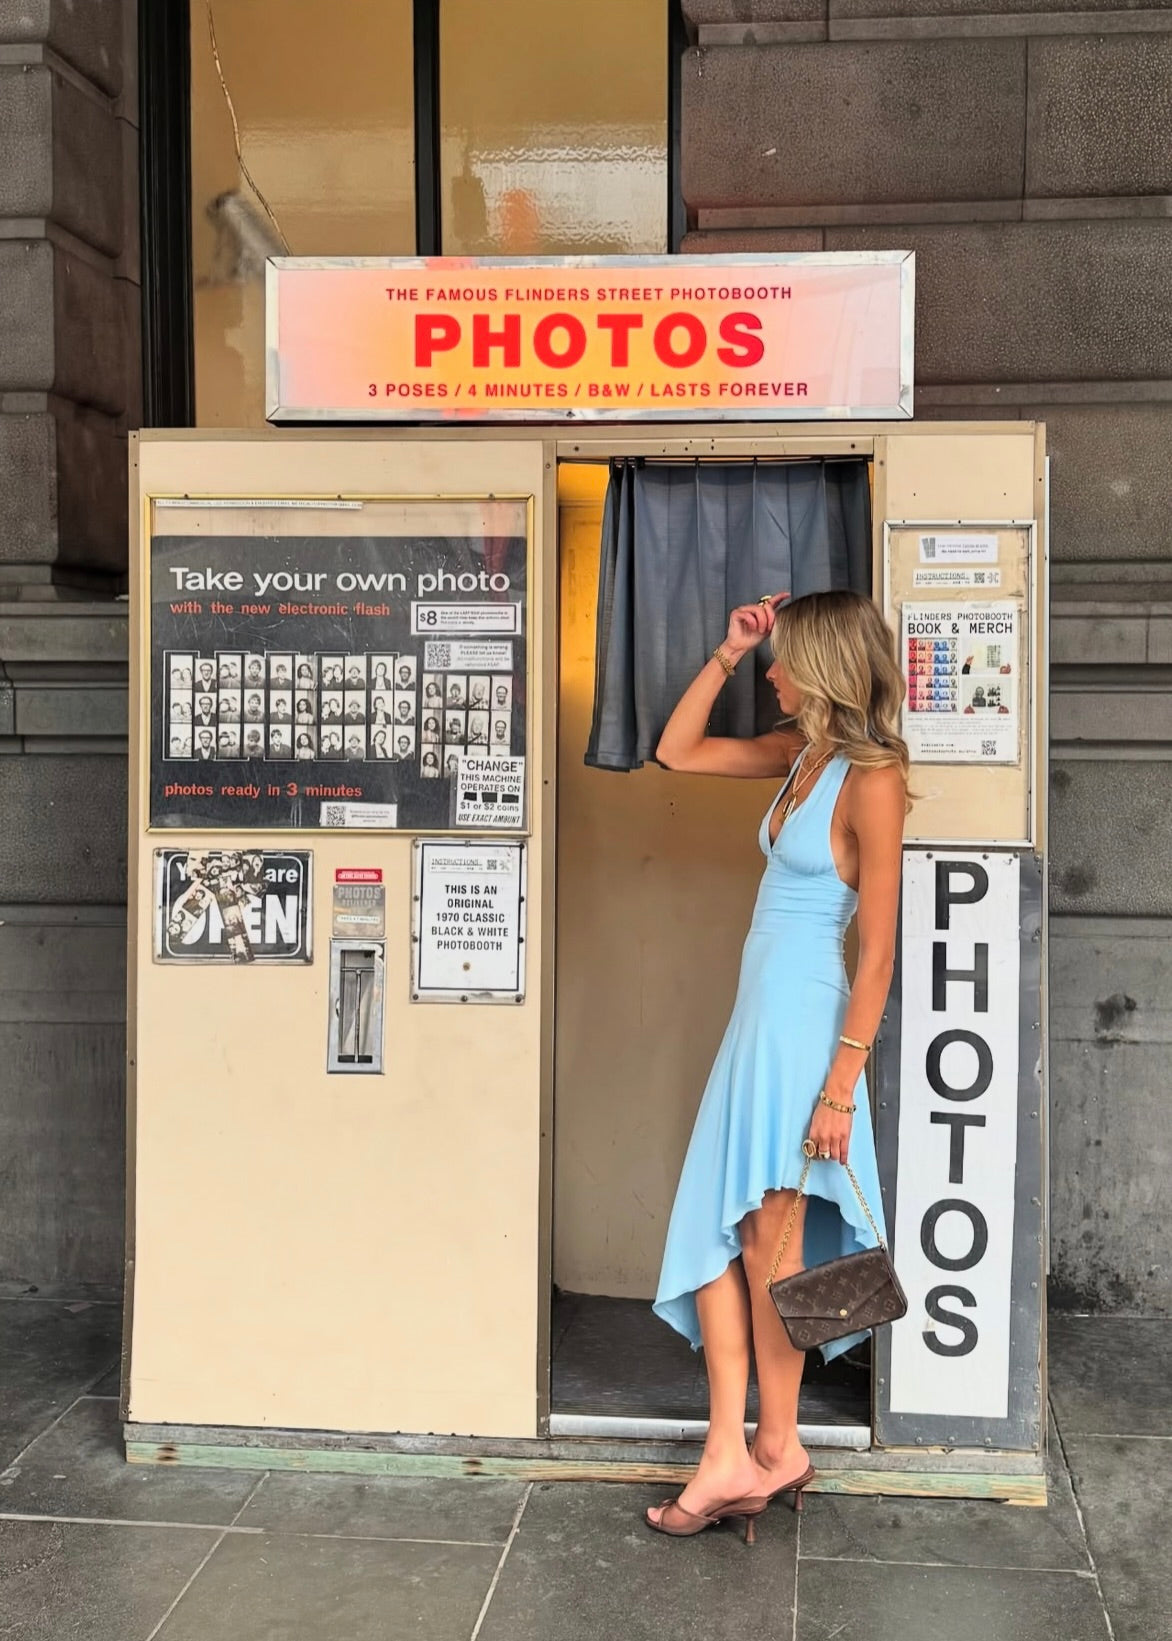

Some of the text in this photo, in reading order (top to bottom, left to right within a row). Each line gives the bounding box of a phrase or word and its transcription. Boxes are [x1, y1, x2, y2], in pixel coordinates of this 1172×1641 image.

[386, 287, 792, 301] THE FAMOUS FLINDERS STREET PHOTOBOOTH
[415, 312, 764, 369] PHOTOS
[369, 383, 808, 397] 3 POSES / 4 MINUTES / B&W / LASTS FOREVER
[169, 567, 510, 597] Take your own photo
[170, 601, 390, 616] with the new electronic flash
[420, 611, 437, 625] $8
[908, 612, 1013, 621] FLINDERS PHOTOBOOTH
[908, 623, 1013, 634] BOOK & MERCH
[460, 773, 522, 783] THIS MACHINE
[164, 783, 362, 798] photos ready in 3 minutes
[460, 783, 505, 792] OPERATES
[460, 801, 470, 810] $1
[484, 803, 494, 811] $2
[497, 804, 519, 812] coins
[458, 814, 521, 824] USE EXACT AMOUNT
[264, 868, 298, 883] are
[337, 887, 381, 900] PHOTOS
[445, 884, 497, 895] THIS IS AN
[447, 898, 494, 909] ORIGINAL
[436, 912, 505, 923] 1970 CLASSIC
[431, 926, 509, 937] BLACK & WHITE
[437, 940, 503, 951] PHOTOBOOTH
[919, 860, 993, 1358] PHOTOS
